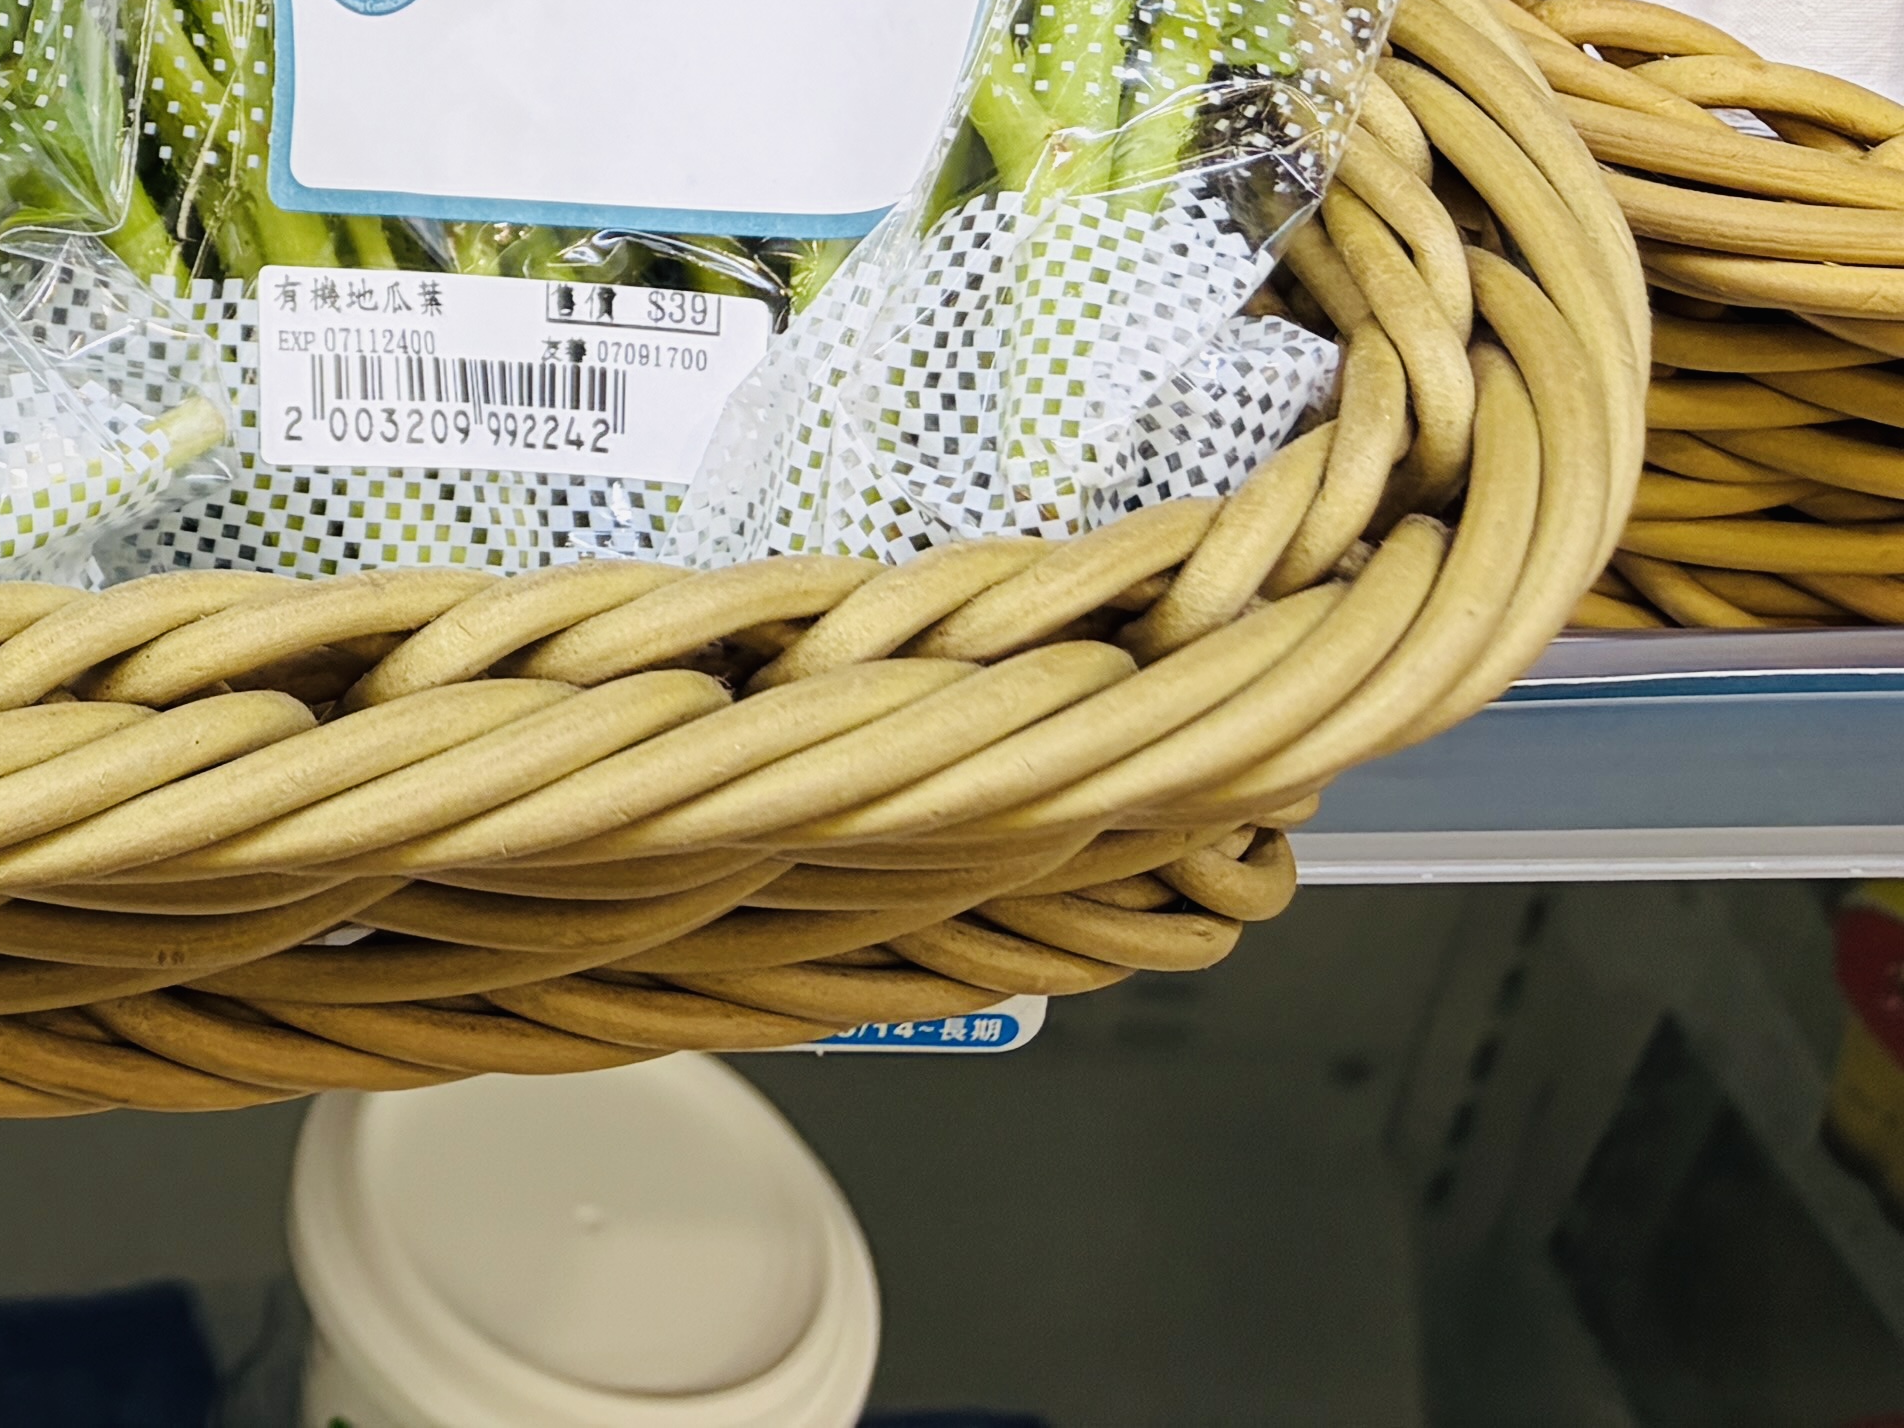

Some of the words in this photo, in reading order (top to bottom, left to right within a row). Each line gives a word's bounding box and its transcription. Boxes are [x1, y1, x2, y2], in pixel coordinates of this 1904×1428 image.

[273, 274, 445, 317] 有機地瓜葉
[646, 289, 709, 327] $39
[277, 329, 317, 352] EXP
[323, 326, 436, 355] 07112400
[283, 405, 304, 442] 2
[328, 406, 472, 445] 003209
[487, 411, 612, 454] 992242
